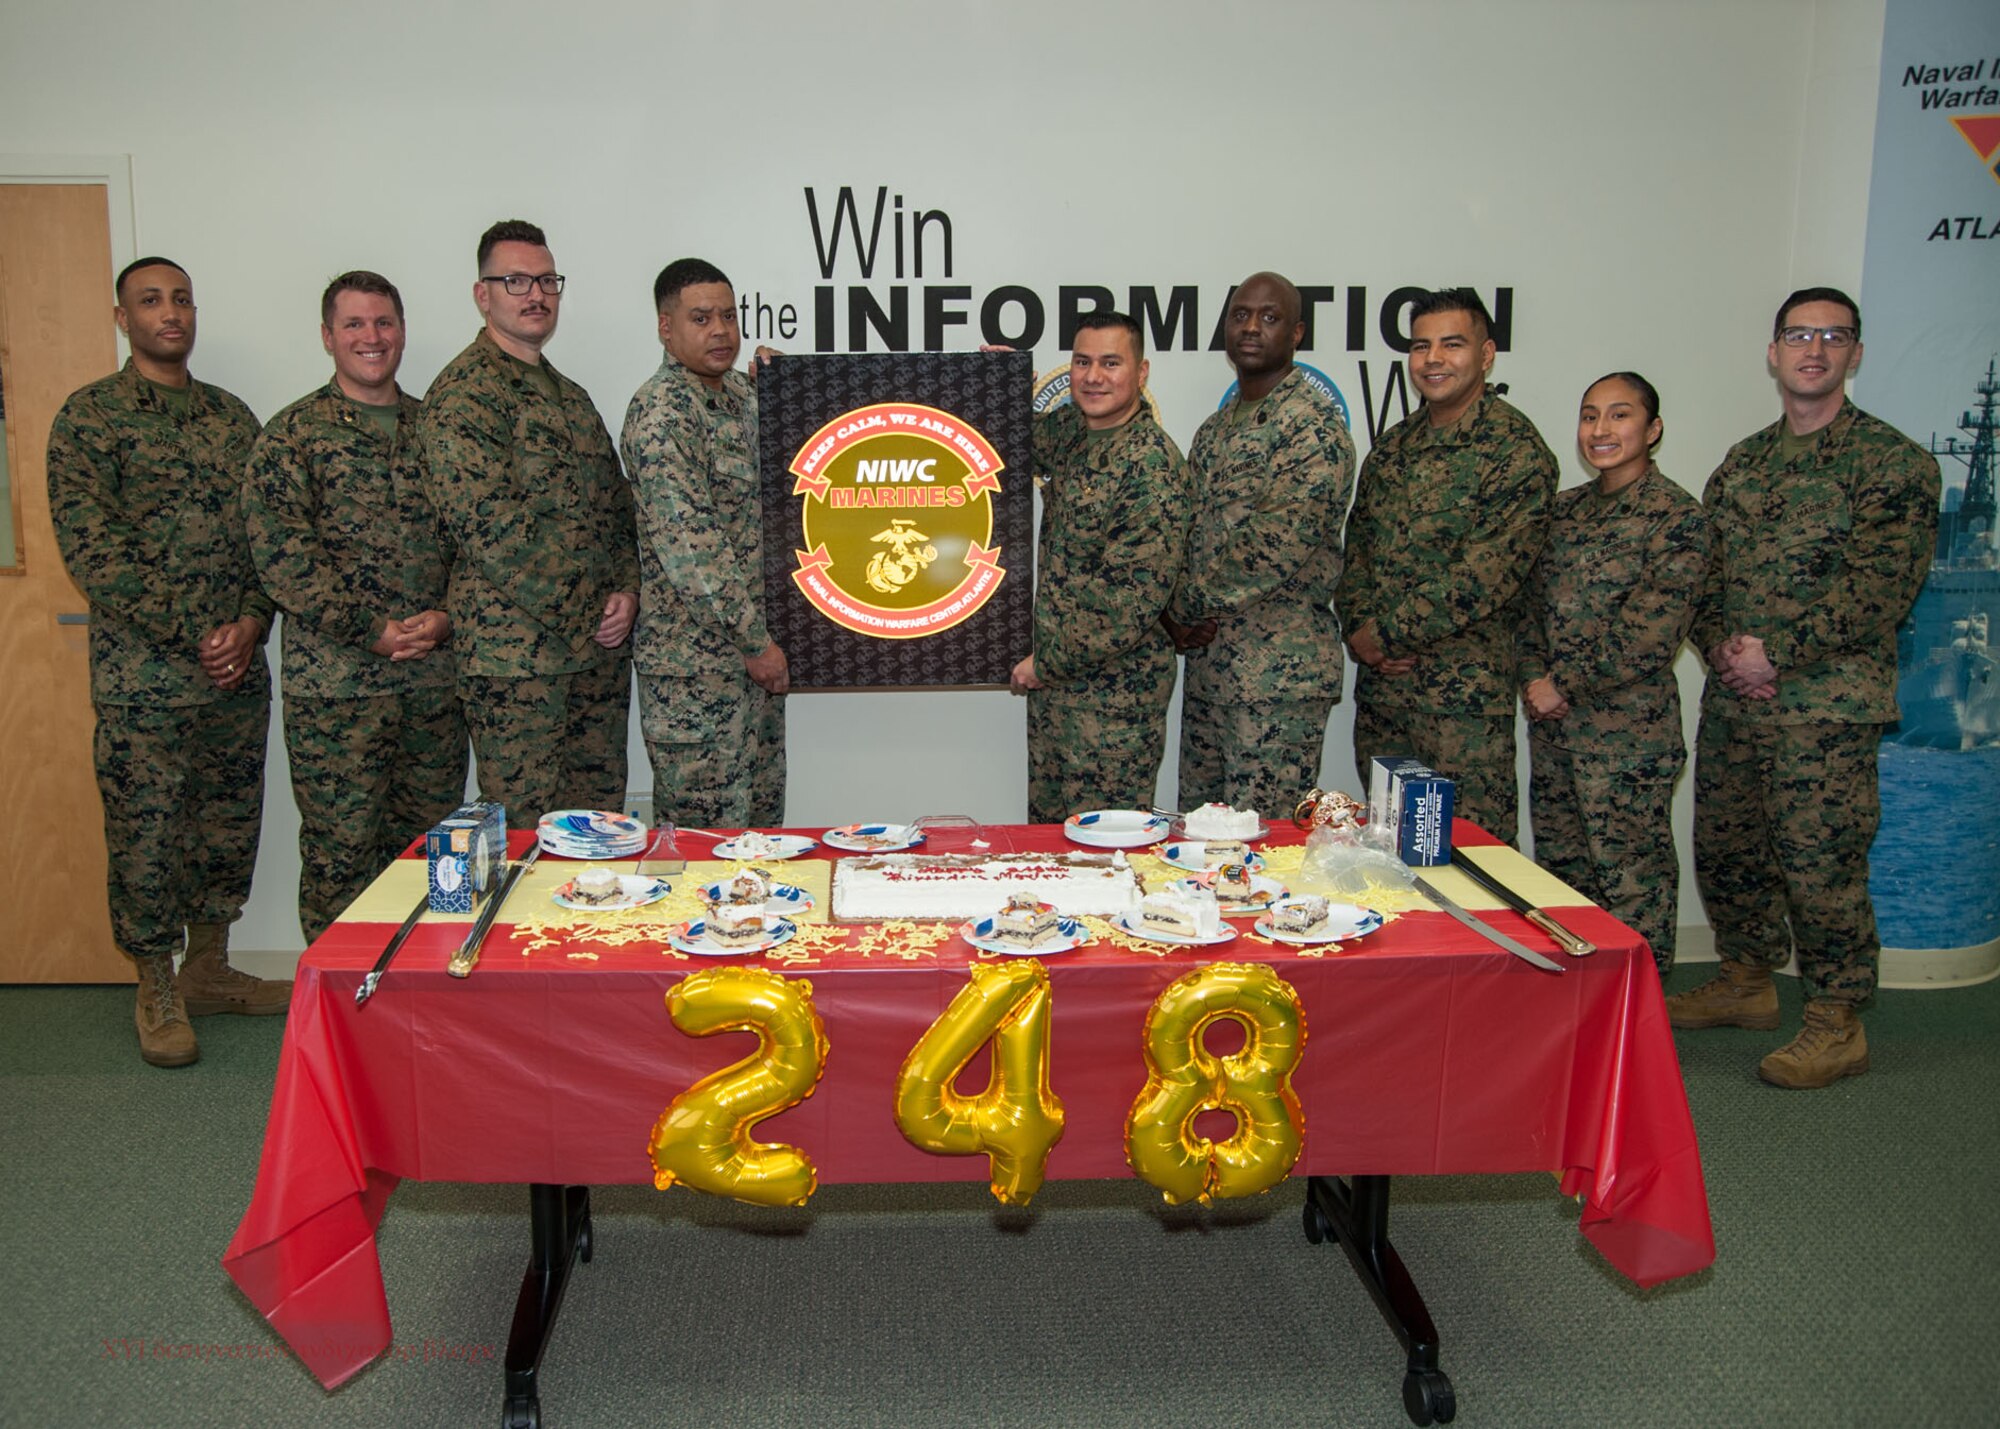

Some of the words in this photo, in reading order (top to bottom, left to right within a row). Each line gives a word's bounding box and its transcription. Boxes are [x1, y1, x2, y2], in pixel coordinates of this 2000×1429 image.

[1902, 59, 1985, 87] Naval
[1921, 85, 2000, 110] Warfa
[804, 186, 953, 280] Win
[739, 292, 798, 340] the
[1033, 375, 1071, 412] UNITED
[802, 435, 837, 474] KEEP
[837, 414, 888, 439] CALM,
[889, 413, 917, 427] WE
[918, 417, 955, 439] ARE
[953, 435, 990, 473] HERE
[855, 458, 937, 484] NIWC
[830, 485, 966, 509] MARINES
[806, 574, 830, 602] NAVAL
[827, 595, 885, 628] INFORMATION
[885, 616, 930, 630] WARFARE
[929, 601, 964, 623] CENTER
[961, 569, 994, 606] ATLANTIC
[1412, 797, 1426, 853] Assorted
